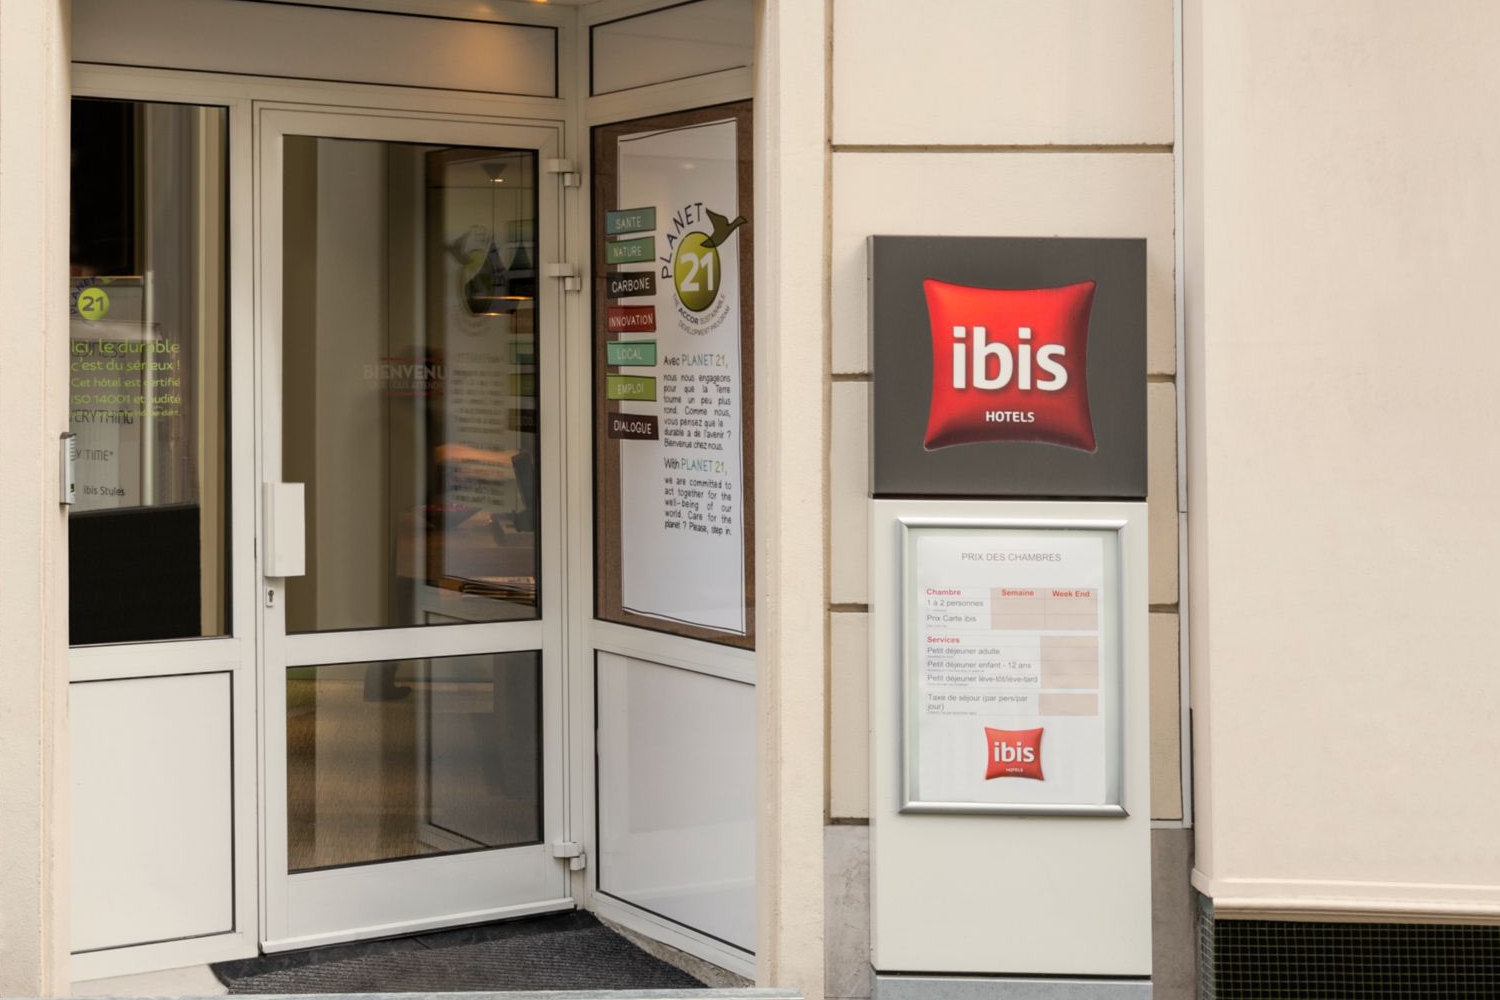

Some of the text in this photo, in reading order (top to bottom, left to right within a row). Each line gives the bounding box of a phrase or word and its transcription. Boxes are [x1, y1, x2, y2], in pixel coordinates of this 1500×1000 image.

[660, 203, 702, 279] PLANET
[614, 246, 642, 257] NATURE
[680, 252, 714, 291] 21
[612, 278, 649, 293] CARBONE
[82, 296, 104, 311] 21
[609, 313, 652, 327] INNOVATION
[678, 308, 699, 325] ACCOR
[72, 339, 93, 356] Ici,
[99, 339, 114, 353] le
[118, 339, 180, 353] durable
[617, 347, 642, 360] LOCAL
[72, 358, 104, 371] c'est
[107, 361, 124, 371] du
[177, 360, 180, 370] !
[664, 355, 728, 368] Avec PLANET 21,
[953, 326, 1068, 391] ibis
[72, 378, 91, 387] Cet
[95, 378, 121, 387] hôtel
[699, 375, 730, 384] engageons
[618, 384, 644, 394] EMPLOI
[664, 386, 676, 394] pour
[703, 385, 708, 393] la
[716, 385, 730, 393] Terre
[718, 397, 730, 406] plus
[685, 406, 707, 415] Comme
[985, 411, 1035, 423] HOTELS
[614, 420, 652, 434] DIALOGUE
[680, 419, 702, 427] pensez
[704, 420, 715, 428] que
[718, 419, 723, 427] le
[665, 428, 683, 436] durable
[694, 429, 700, 437] de
[727, 430, 731, 438] ?
[664, 439, 692, 448] Bienvenue
[693, 440, 707, 449] chez
[664, 457, 727, 475] With PLANET 21,
[690, 479, 722, 488] committed
[100, 486, 125, 496] Styles
[678, 488, 703, 499] together
[708, 490, 716, 499] for
[721, 492, 732, 501] the
[665, 498, 699, 511] well-being
[707, 501, 713, 510] of
[688, 511, 702, 520] Care
[708, 513, 716, 522] for
[722, 514, 732, 524] the
[665, 520, 680, 530] planet
[683, 521, 686, 529] ?
[711, 526, 723, 536] step
[961, 553, 1061, 561] PRIX DES CHAMBRES
[1001, 589, 1034, 597] Semaine
[946, 647, 976, 656] déjeuner
[945, 661, 976, 669] déjeuner
[945, 675, 976, 683] déjeuner
[959, 695, 980, 703] séjour
[994, 742, 1035, 762] ibis
